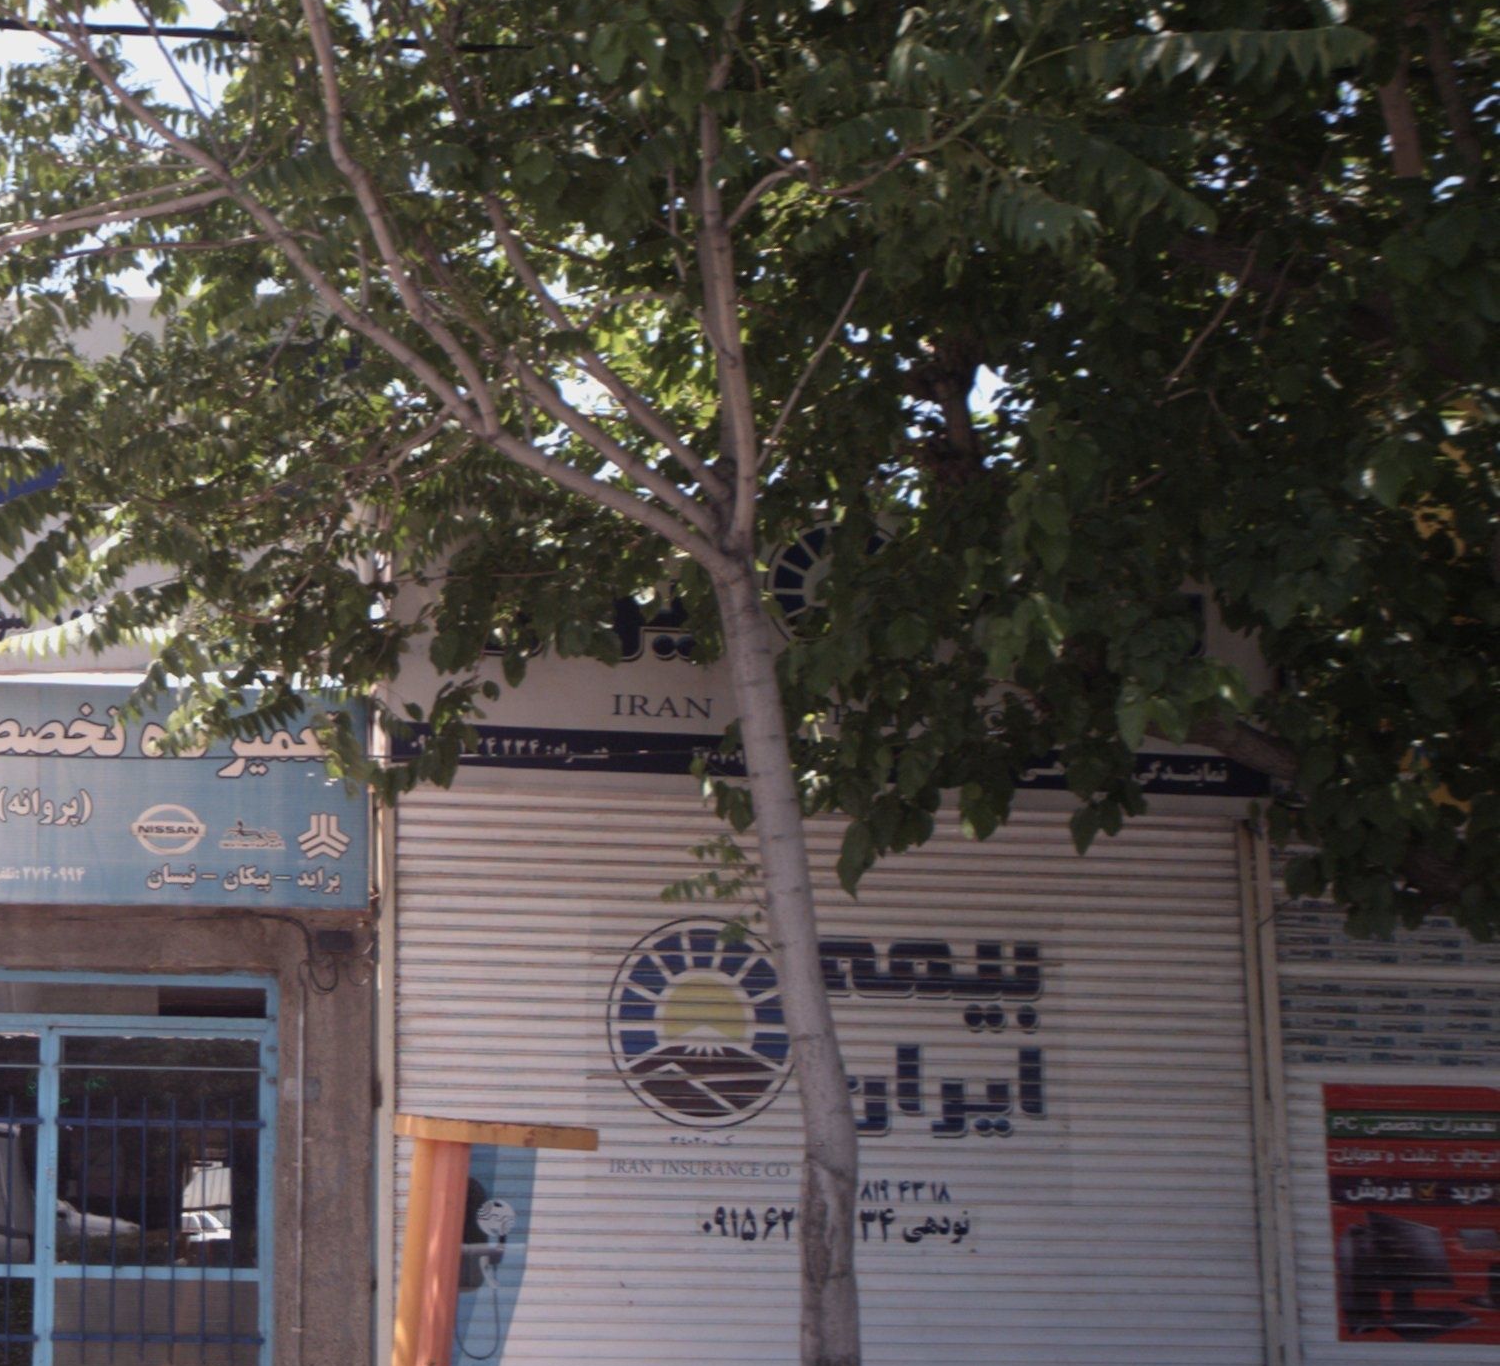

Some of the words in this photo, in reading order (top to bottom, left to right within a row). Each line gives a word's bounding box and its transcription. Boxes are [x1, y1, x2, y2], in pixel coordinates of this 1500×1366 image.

[611, 693, 714, 720] IRAN
[137, 823, 199, 836] NISSAN
[146, 861, 198, 891] نیسان
[222, 864, 272, 894] پیکان
[1331, 1115, 1359, 1131] PC
[608, 1157, 653, 1176] IRAN
[661, 1158, 762, 1178] INSURANCE
[763, 1160, 792, 1178] CO
[1344, 1176, 1414, 1202] فروش
[1450, 1181, 1495, 1205] خرید
